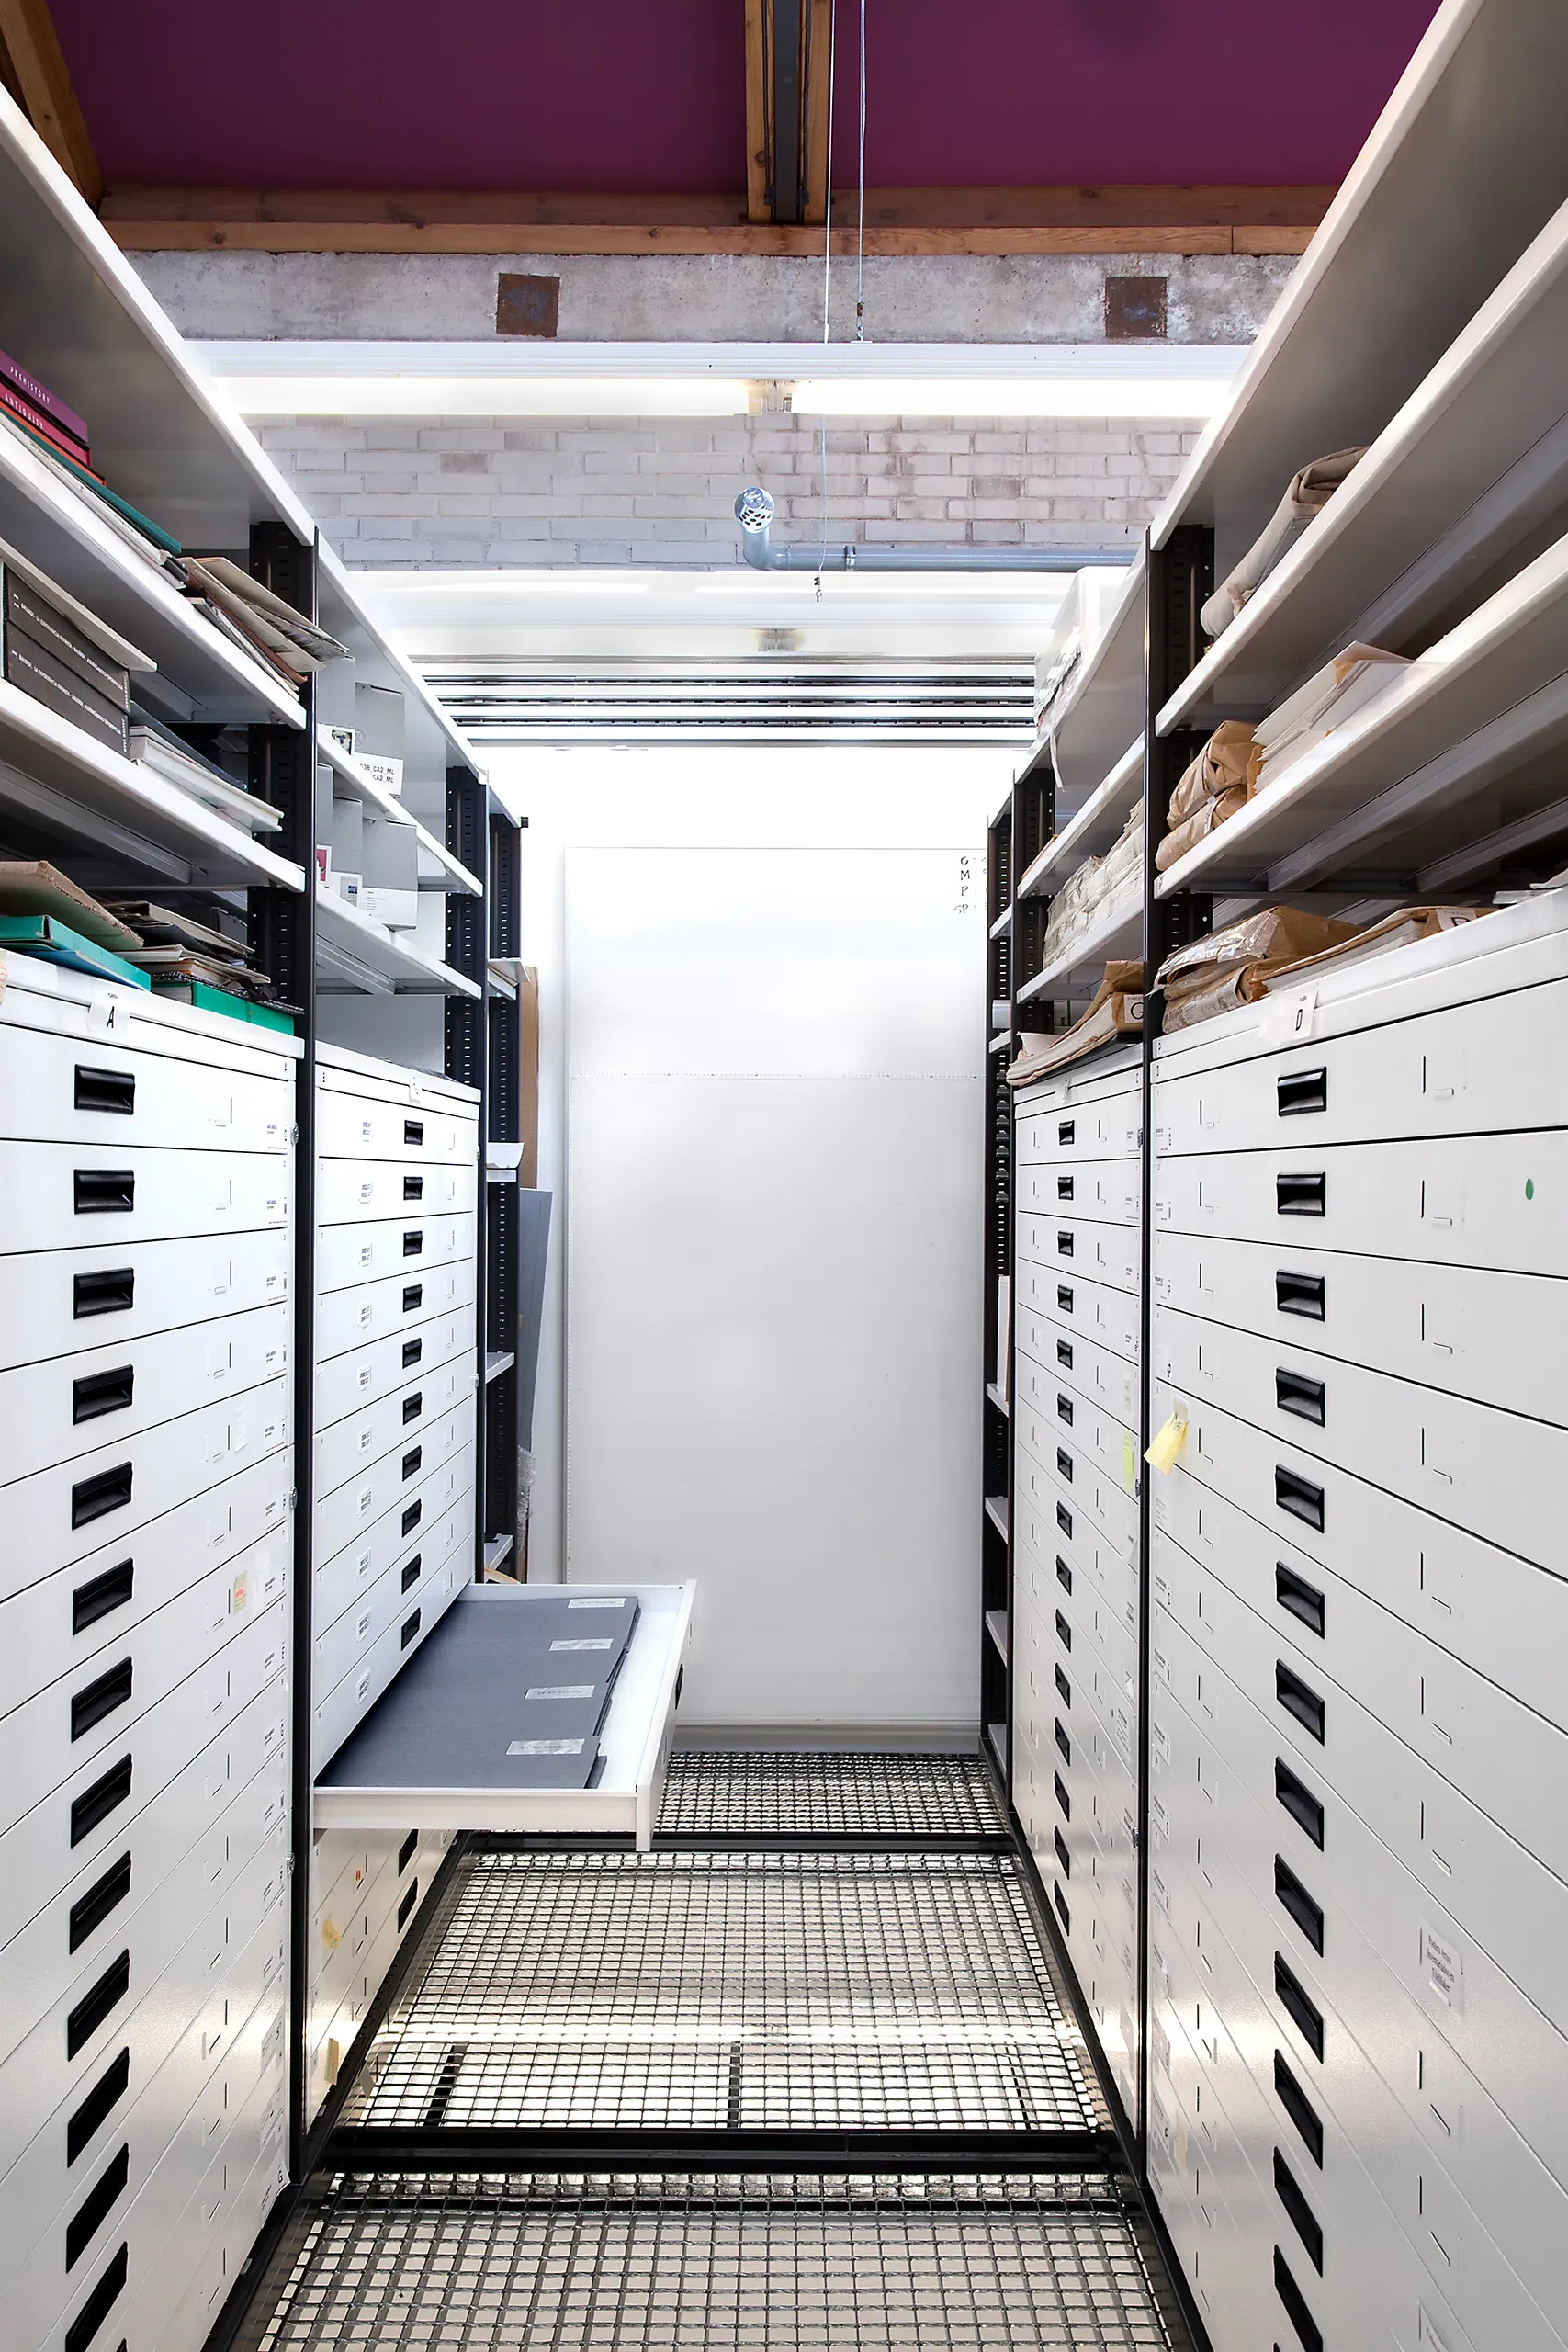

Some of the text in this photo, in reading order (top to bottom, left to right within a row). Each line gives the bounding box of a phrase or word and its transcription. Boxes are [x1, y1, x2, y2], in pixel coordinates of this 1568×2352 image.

[9, 366, 51, 405] PREHISTORY
[4, 393, 44, 430] ANTIQUITY
[107, 1006, 115, 1028] A
